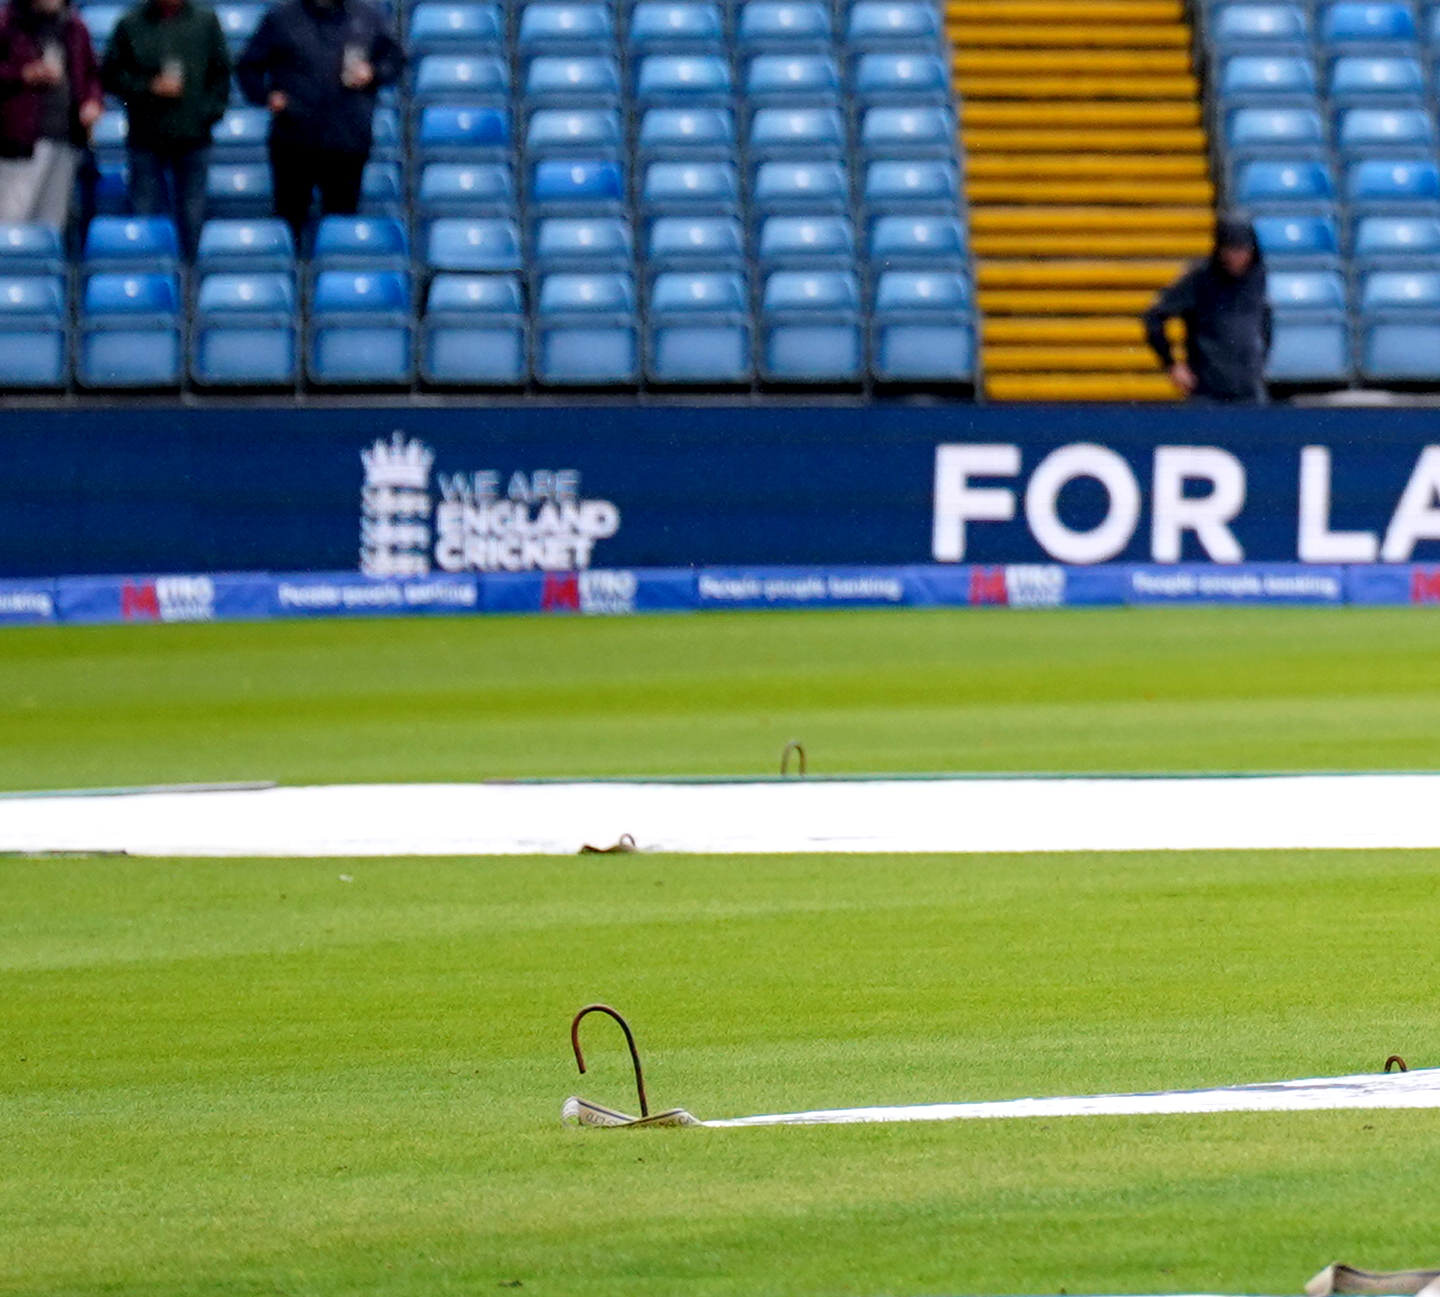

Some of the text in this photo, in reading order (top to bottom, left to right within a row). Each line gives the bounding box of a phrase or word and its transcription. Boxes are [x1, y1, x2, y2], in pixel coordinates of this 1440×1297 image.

[436, 468, 582, 503] WE ARE
[931, 443, 1247, 563] FOR
[436, 499, 621, 540] ENGLAND
[435, 530, 594, 572] CRICKET
